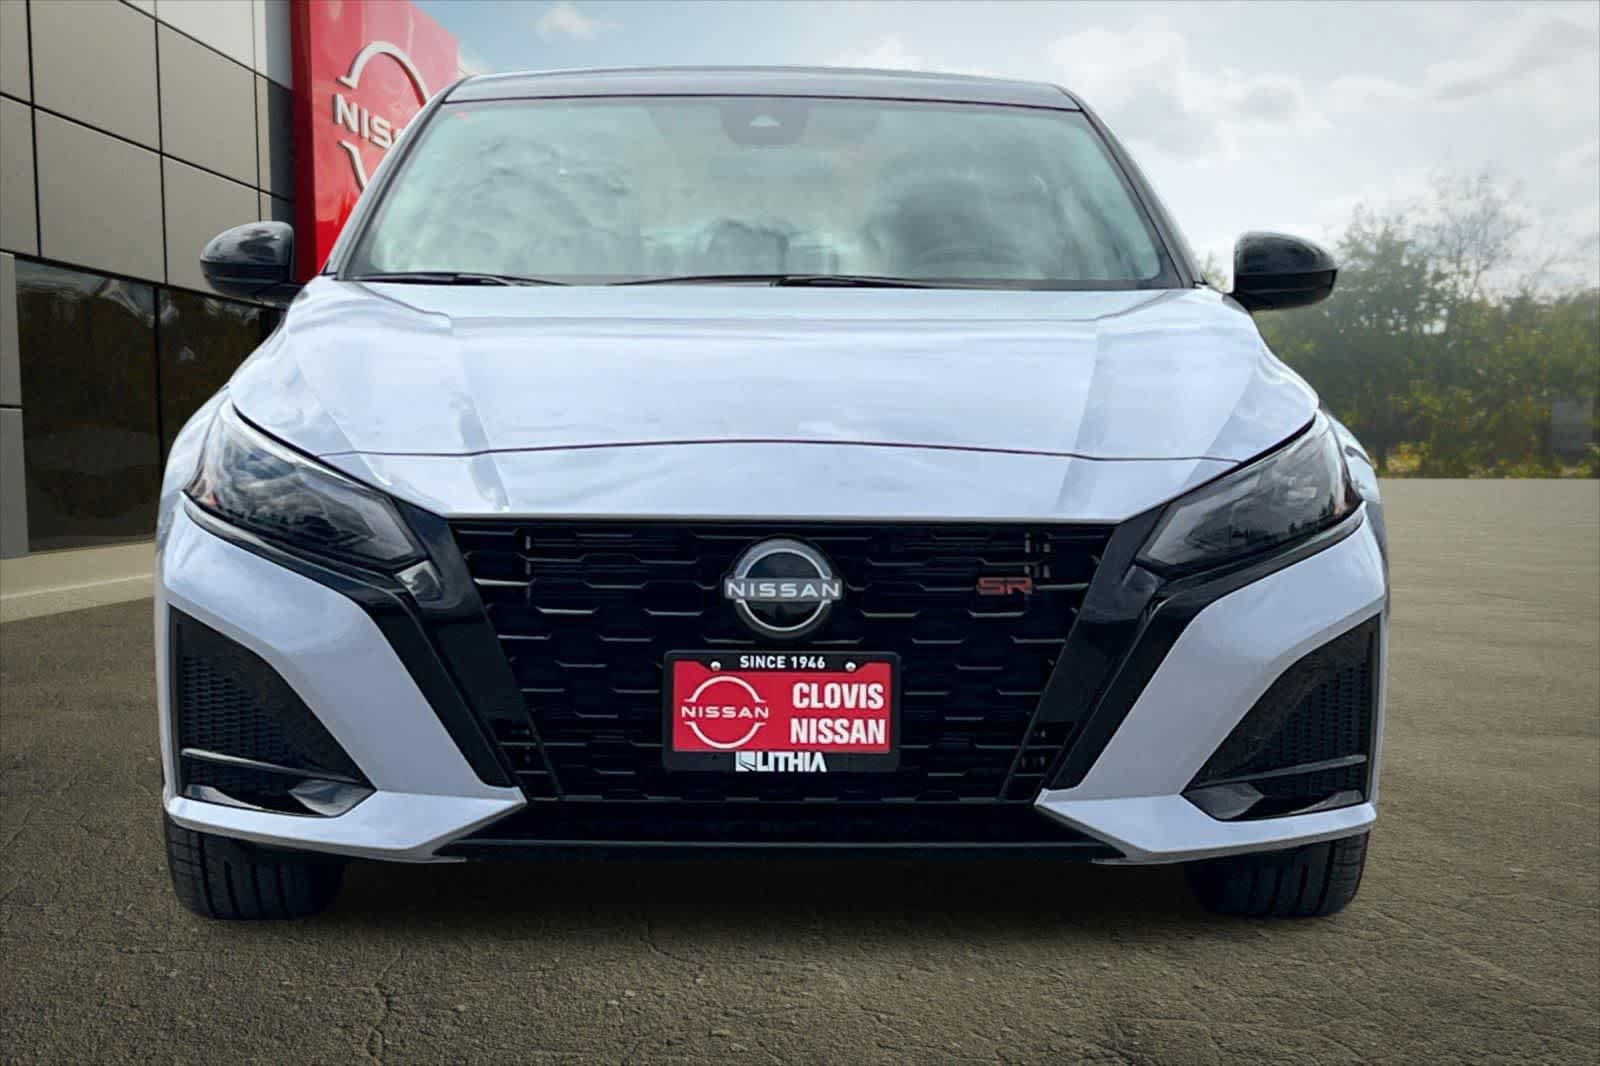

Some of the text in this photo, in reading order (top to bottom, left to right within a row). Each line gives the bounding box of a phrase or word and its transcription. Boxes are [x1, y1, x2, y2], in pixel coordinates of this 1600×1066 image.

[727, 582, 840, 598] NISSAN
[976, 577, 1032, 595] SR
[739, 656, 826, 669] SINCE 1946
[792, 682, 884, 709] CLOVIS
[681, 706, 769, 719] NISSAN
[790, 718, 886, 745] NISSAN
[756, 751, 828, 773] LITHIA
